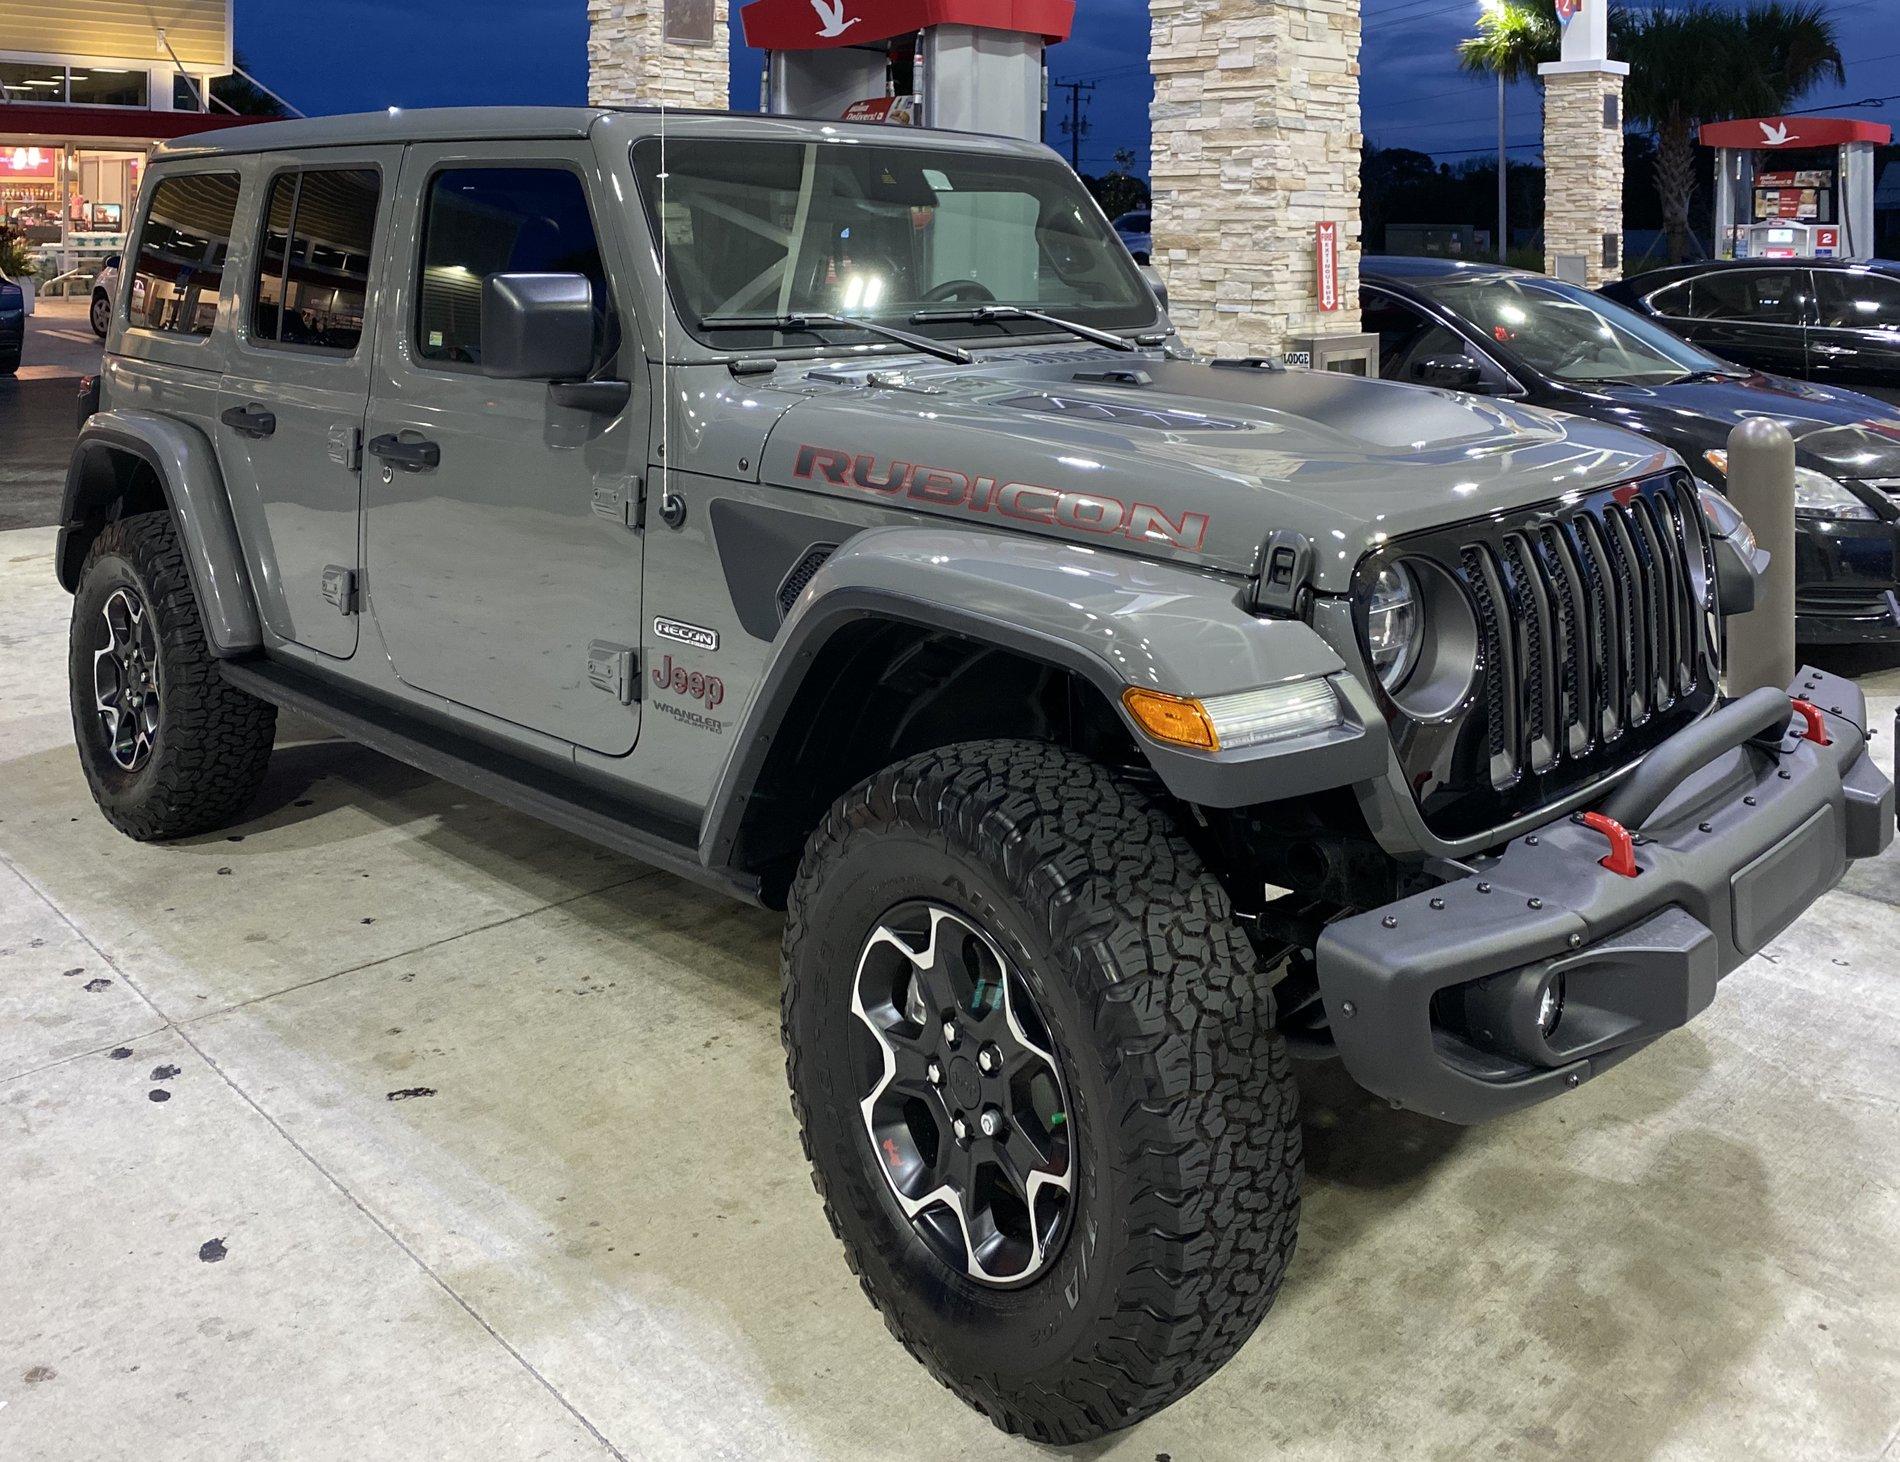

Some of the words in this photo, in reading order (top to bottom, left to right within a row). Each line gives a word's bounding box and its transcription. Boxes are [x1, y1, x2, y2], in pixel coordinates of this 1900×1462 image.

[1822, 233, 1832, 243] 2
[1324, 242, 1332, 305] EXTINGUISHER
[1283, 353, 1309, 364] LODGE
[793, 444, 1209, 551] RUBICON
[658, 623, 712, 645] RECON
[652, 655, 724, 710] Jeep
[652, 699, 722, 729] WRANGLER
